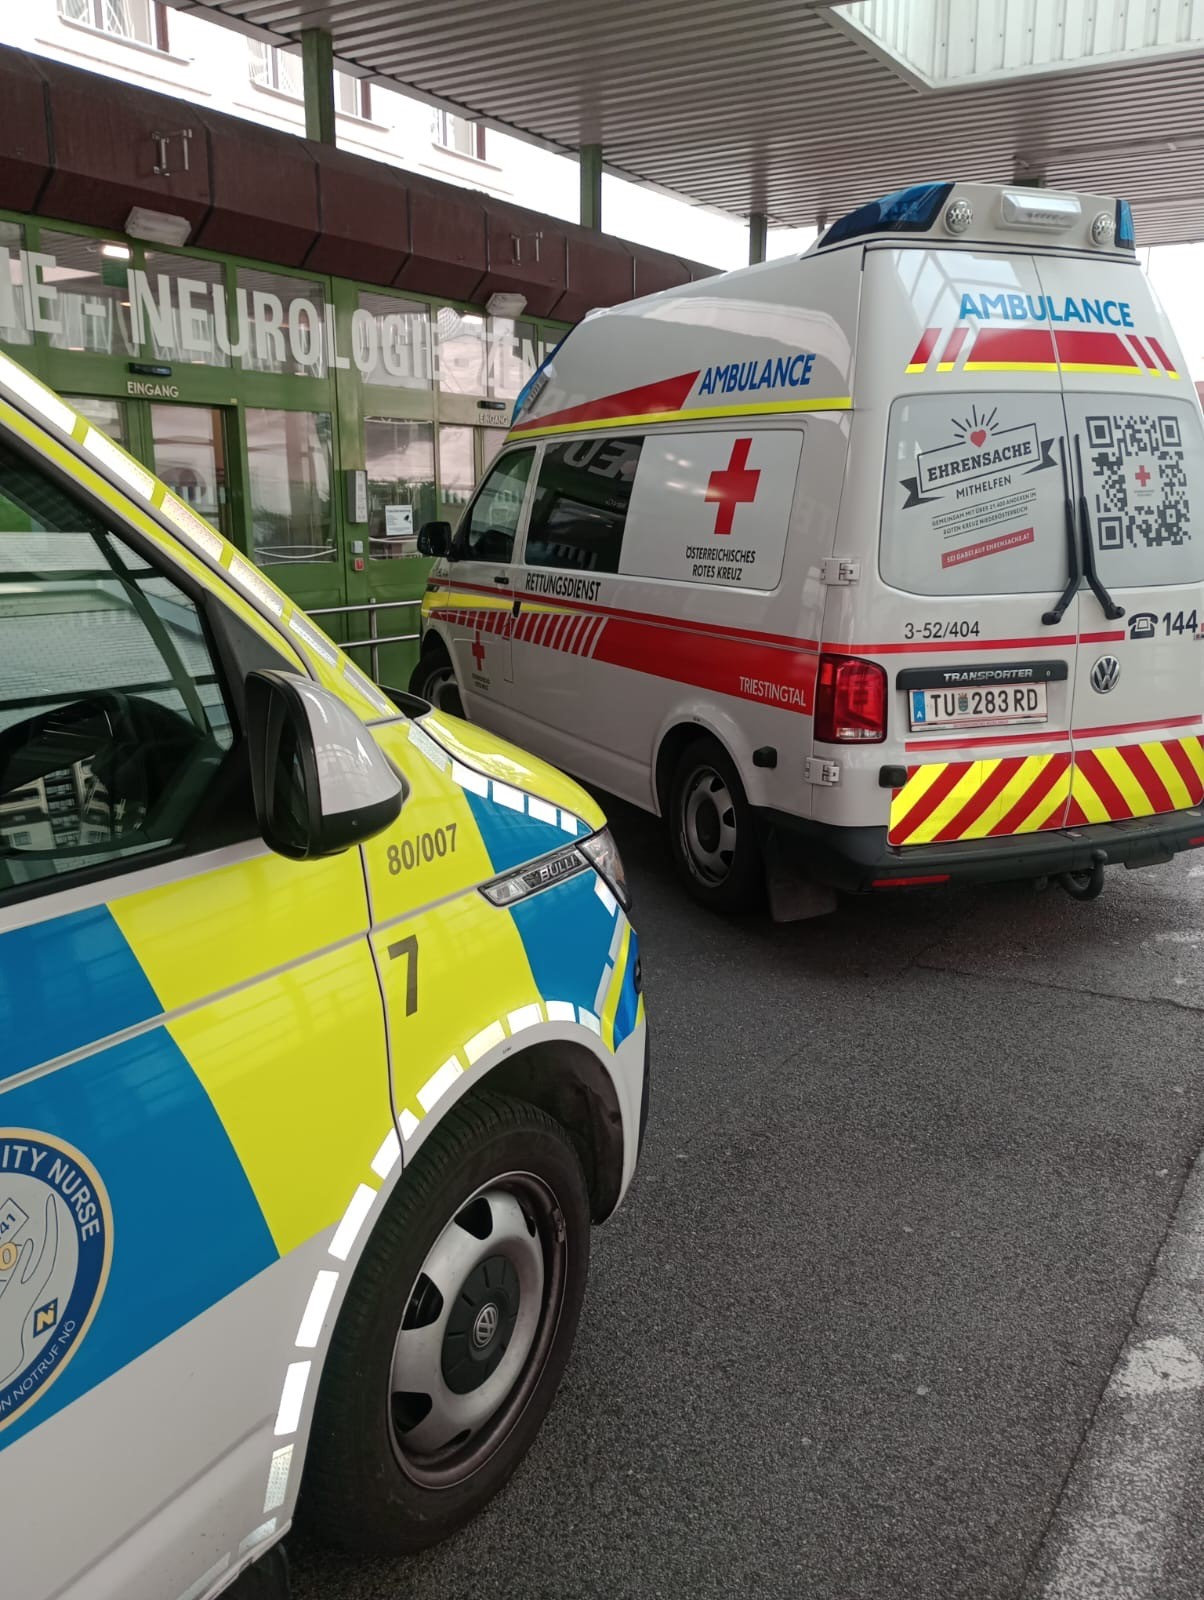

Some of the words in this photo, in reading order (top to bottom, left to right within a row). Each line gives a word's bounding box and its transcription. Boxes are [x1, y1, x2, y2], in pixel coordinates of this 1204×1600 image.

[0, 246, 63, 334] IE
[127, 268, 441, 382] NEUROLOGIE
[959, 293, 1135, 328] AMBULANCE
[698, 353, 816, 397] AMBULANCE
[127, 381, 179, 398] EINGANG
[478, 412, 509, 425] EINGANG
[927, 442, 1032, 481] EHRENSACHE
[956, 474, 1012, 500] MITHELFEN
[932, 511, 965, 526] GEMEINSAM
[965, 508, 976, 518] MIT
[943, 525, 961, 536] ROTEN
[962, 519, 979, 530] KREUZ
[685, 545, 756, 564] ÖSTERREICHISCHES
[692, 563, 716, 578] ROTES
[717, 566, 743, 581] KREUZ
[525, 572, 602, 601] RETTUNGSDIENST
[904, 620, 981, 640] 3-52/404
[1162, 609, 1199, 636] 144
[943, 668, 1033, 682] TRANSPORTER
[738, 675, 807, 707] TRIESTINGTAL
[930, 693, 956, 717] TU
[386, 822, 458, 877] 80/007
[387, 933, 419, 1018] 7
[0, 1144, 48, 1172] ITY
[47, 1158, 100, 1242] NURSE
[13, 1343, 60, 1400] NOTRUF
[58, 1319, 76, 1344] NÖ
